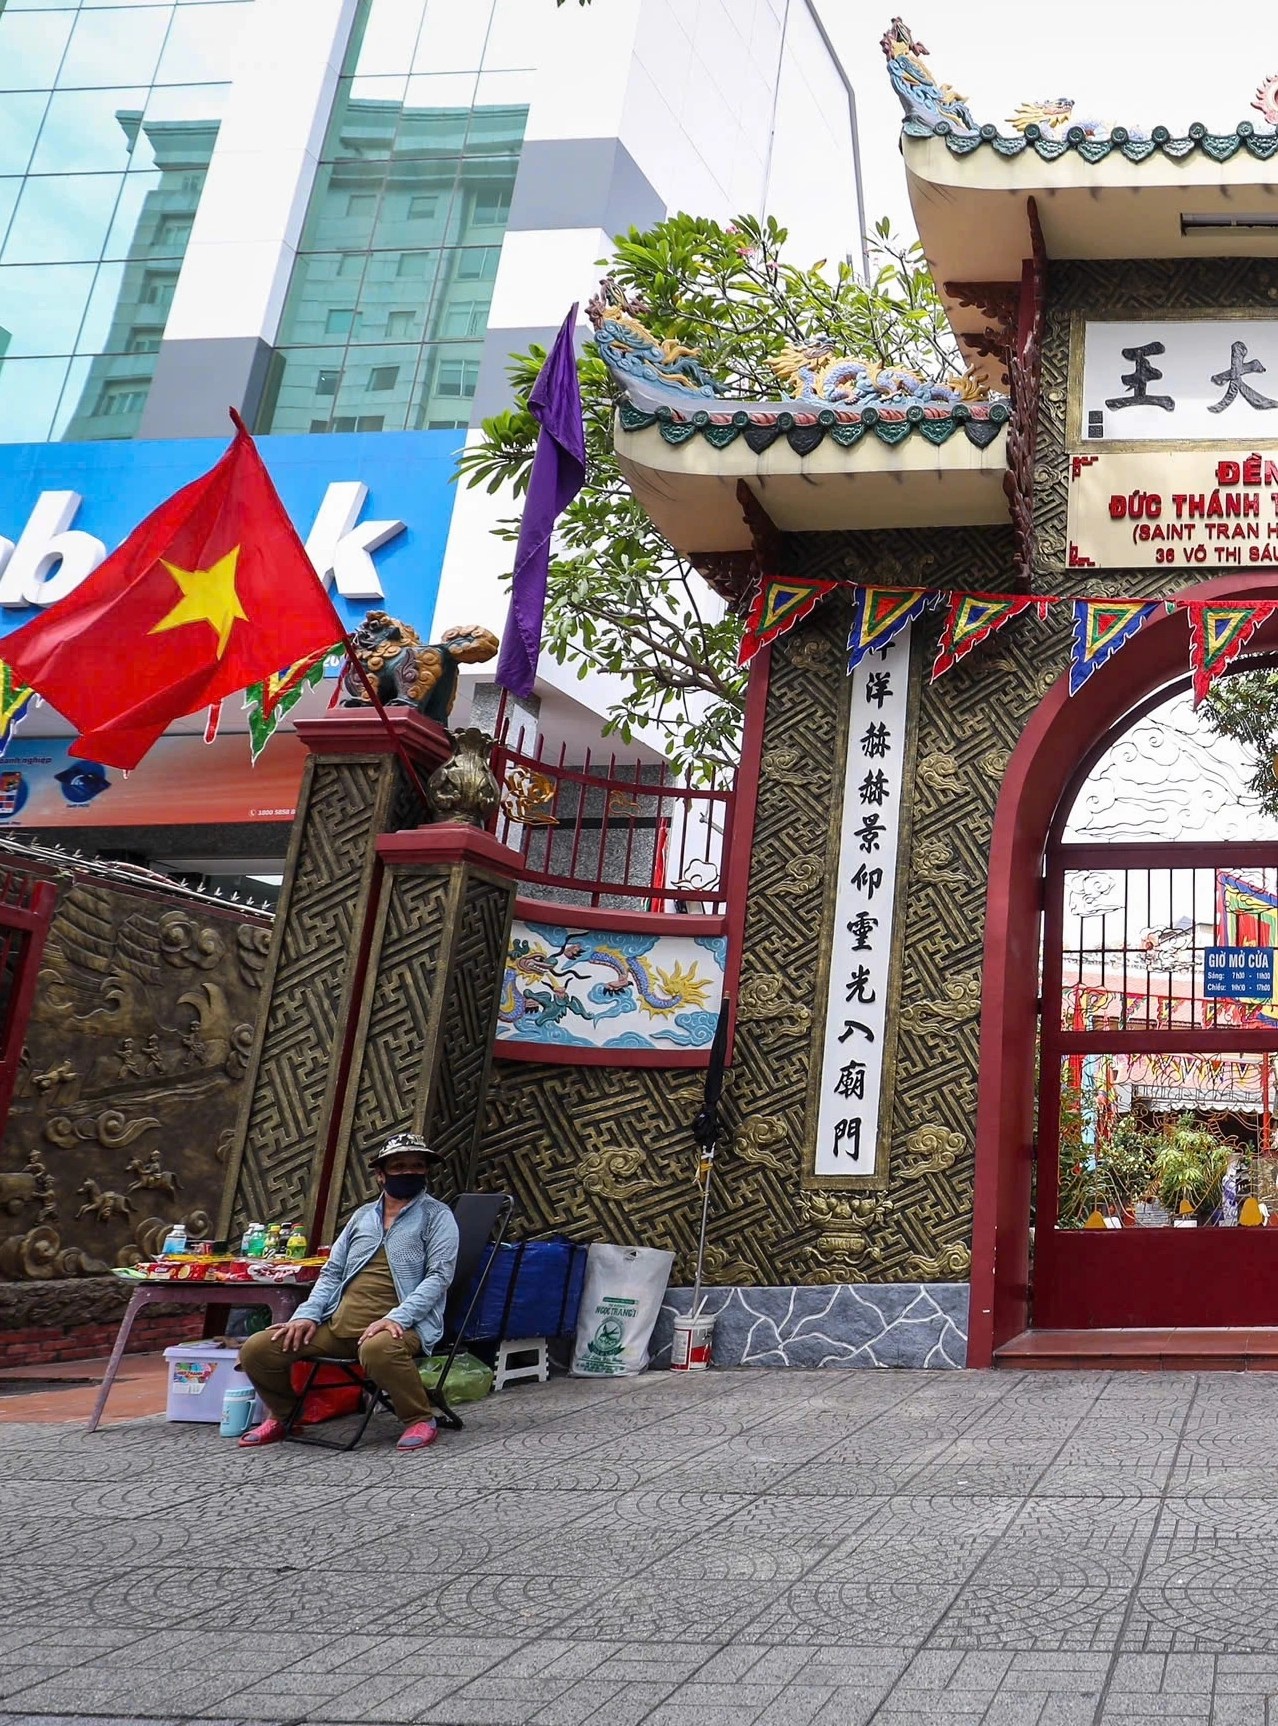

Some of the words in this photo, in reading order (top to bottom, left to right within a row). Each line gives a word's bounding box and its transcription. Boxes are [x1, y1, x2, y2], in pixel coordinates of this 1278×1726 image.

[1109, 490, 1162, 519] ĐỨC
[1172, 489, 1260, 518] THÁNH
[1133, 523, 1196, 544] (SAINT
[1205, 522, 1259, 540] TRAN
[1156, 547, 1175, 563] 36
[1183, 544, 1207, 562] VÕ
[1214, 546, 1241, 564] THỊ
[1208, 951, 1226, 968] GIỜ
[1229, 950, 1246, 968] MỞ
[1248, 950, 1269, 968] CỬA
